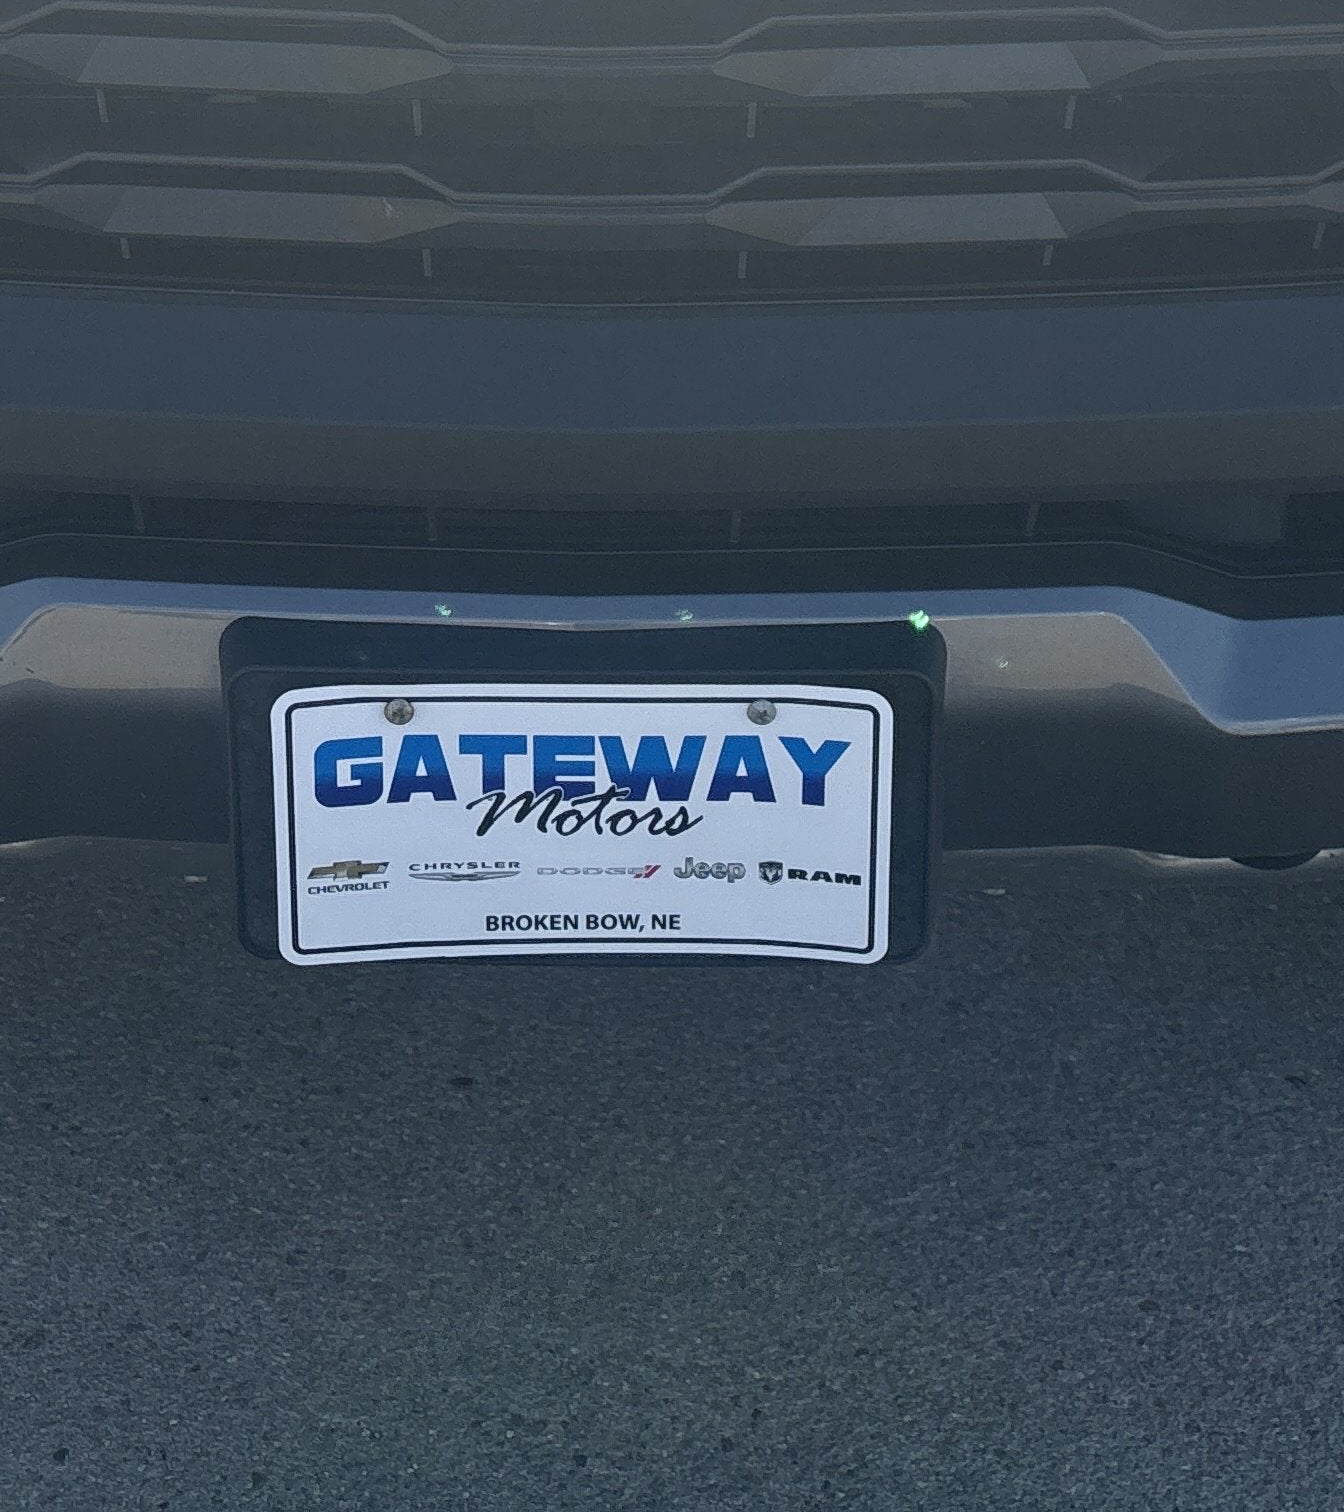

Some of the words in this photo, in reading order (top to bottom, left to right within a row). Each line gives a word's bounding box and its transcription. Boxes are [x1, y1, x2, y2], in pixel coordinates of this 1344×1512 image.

[313, 734, 852, 808] GATEWAY
[465, 784, 705, 837] Motors
[408, 860, 521, 872] CHRYSLER
[536, 866, 635, 877] DODGE
[673, 857, 747, 883] Jeep
[787, 868, 863, 887] RAM
[307, 880, 390, 896] CHEVROLET
[485, 914, 580, 932] BROKEN
[586, 914, 646, 935] BOW,
[651, 914, 682, 931] NE
